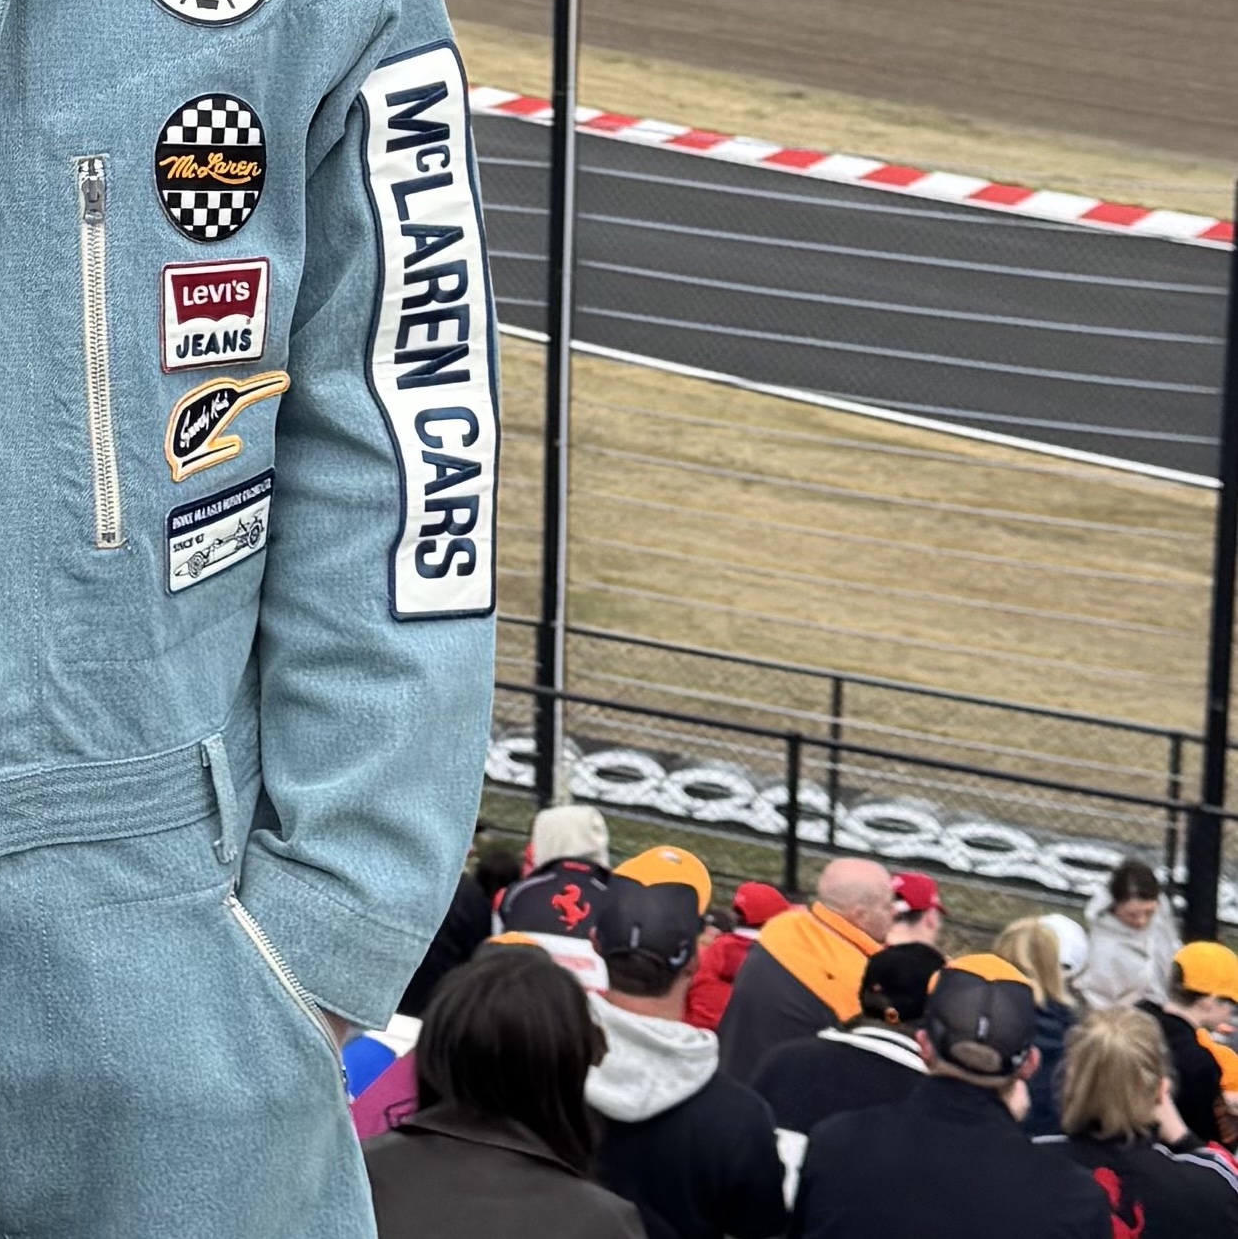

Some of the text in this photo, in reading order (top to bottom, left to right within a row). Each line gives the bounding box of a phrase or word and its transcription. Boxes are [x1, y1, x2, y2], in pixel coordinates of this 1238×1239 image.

[158, 152, 262, 185] McLaren
[175, 327, 253, 359] JEANS
[383, 80, 481, 580] McLAREN CARS
